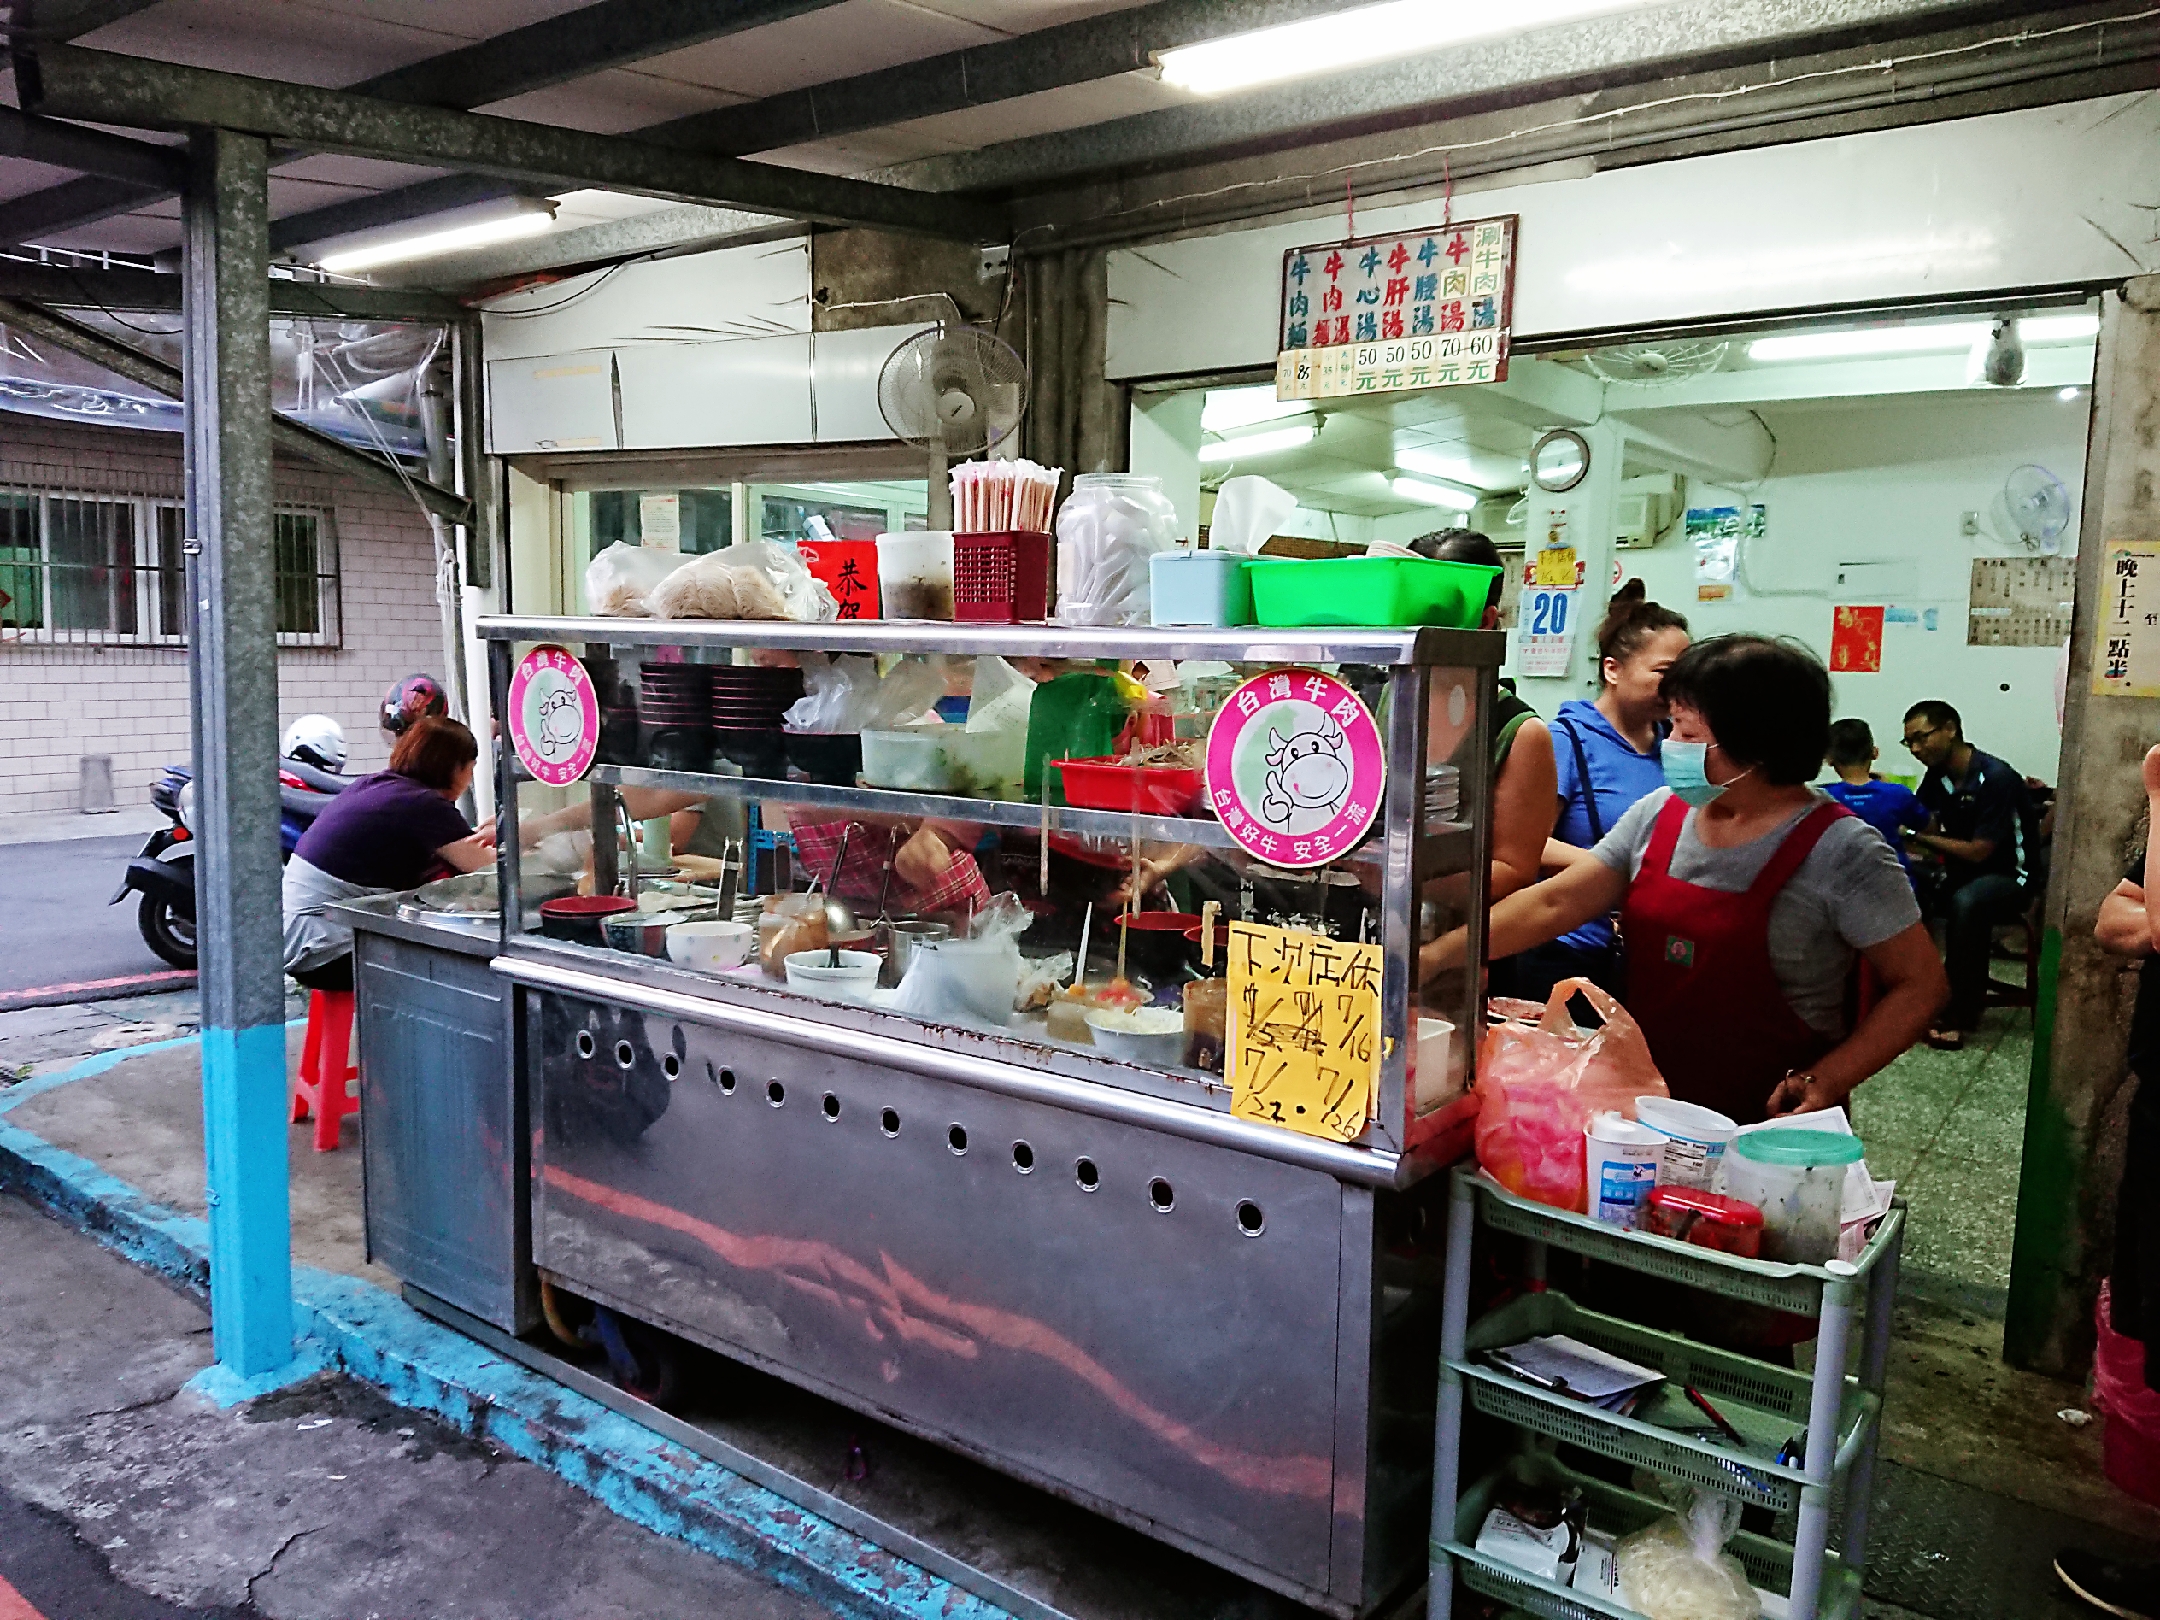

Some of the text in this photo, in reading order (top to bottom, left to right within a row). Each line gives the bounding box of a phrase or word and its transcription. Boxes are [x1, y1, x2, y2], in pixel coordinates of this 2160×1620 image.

[1287, 255, 1311, 348] 牛肉麵
[1356, 246, 1382, 341] 牛心湯
[1382, 242, 1410, 338] 牛肝湯
[1412, 238, 1439, 333] 牛腰湯
[1441, 233, 1470, 332] 牛肉湯
[1533, 592, 1568, 635] 20
[2107, 559, 2139, 679] 晚上十二點半
[1237, 674, 1360, 727] 台灣牛肉
